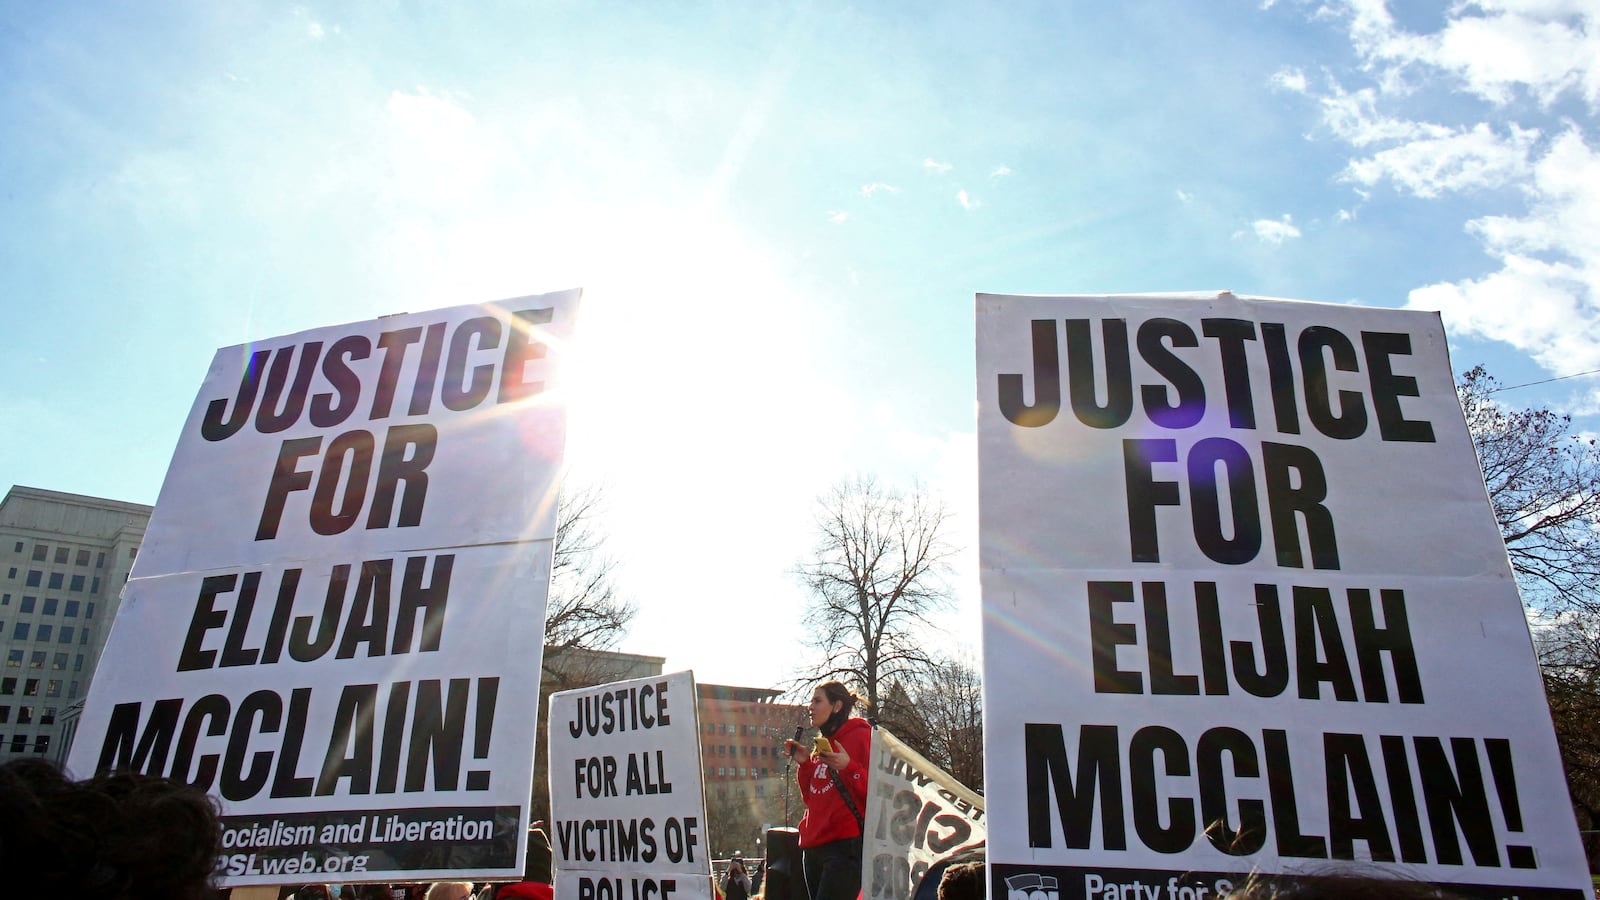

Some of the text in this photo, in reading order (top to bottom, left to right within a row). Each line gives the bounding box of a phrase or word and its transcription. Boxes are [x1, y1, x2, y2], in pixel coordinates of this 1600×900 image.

[201, 307, 554, 441] JUSTICE
[998, 317, 1436, 443] JUSTICE
[254, 423, 437, 541] FOR
[1123, 437, 1340, 570] FOR
[176, 554, 455, 672] ELIJAH
[1087, 580, 1425, 704] ELIJAH
[94, 676, 500, 801] MCCLAIN!
[569, 681, 670, 739] JUSTICE
[220, 815, 494, 849] ocialism and Liberation
[575, 750, 672, 798] FOR ALL
[1024, 723, 1537, 869] MCCLAIN!
[557, 817, 698, 863] VICTIMS OF
[1085, 874, 1161, 900] Party
[1167, 877, 1209, 900] for
